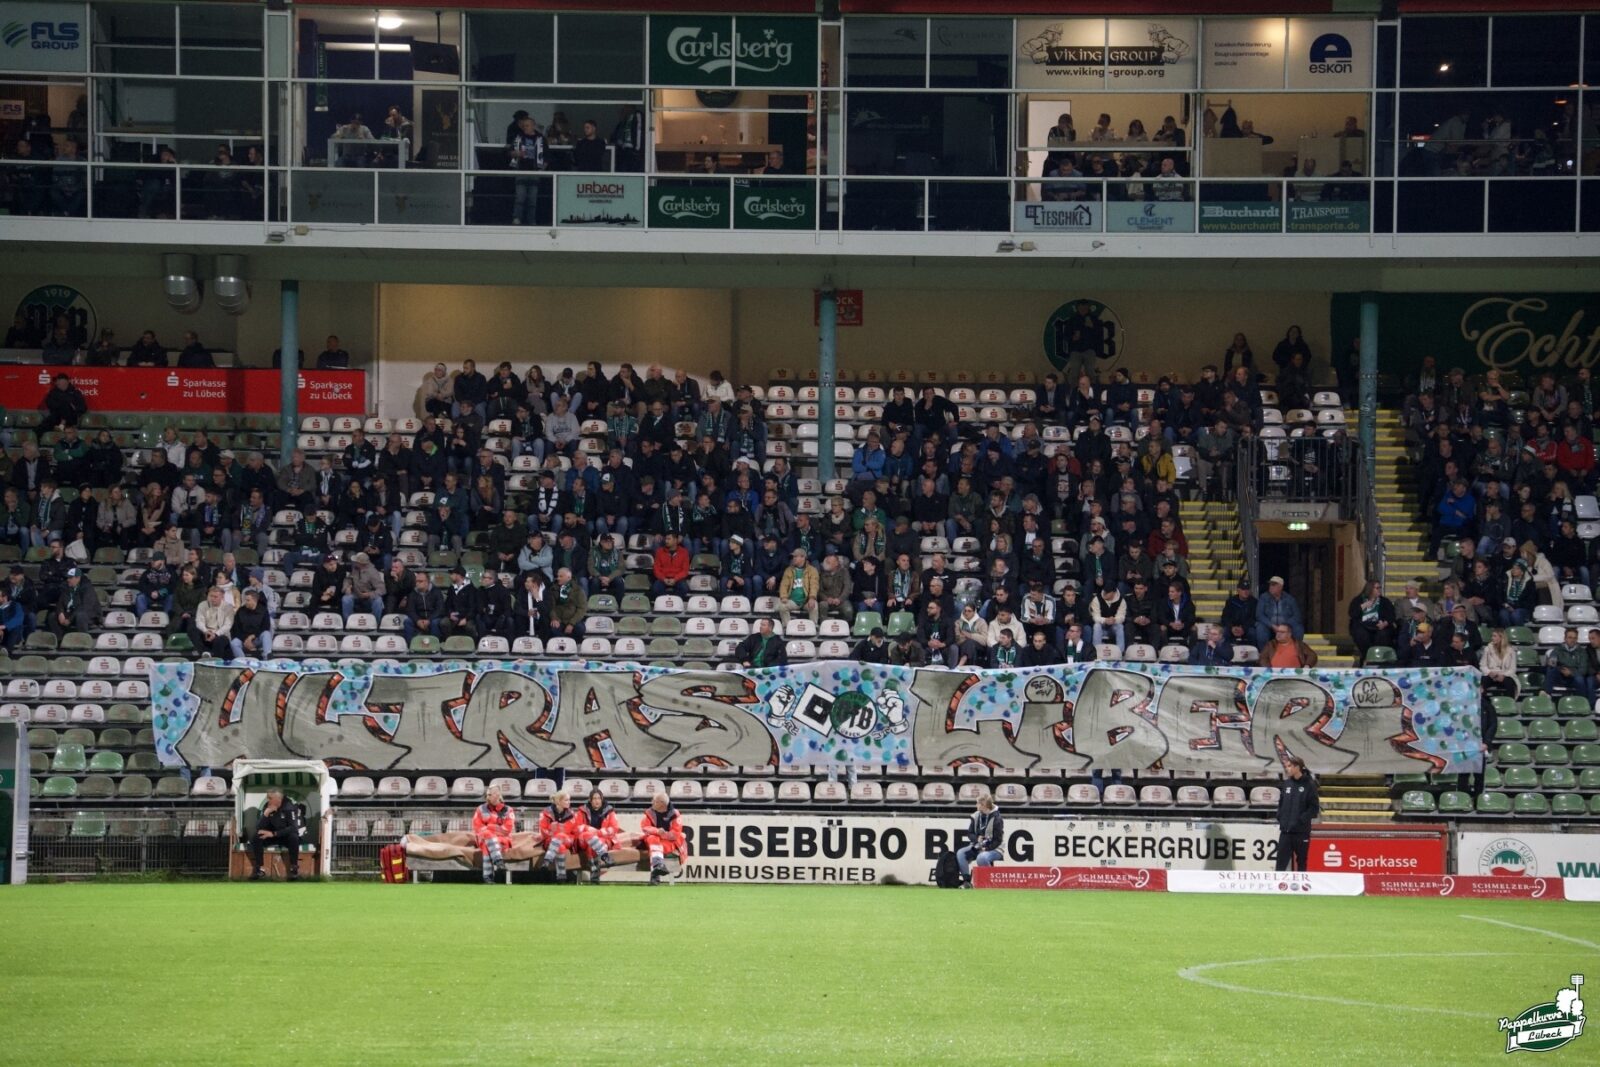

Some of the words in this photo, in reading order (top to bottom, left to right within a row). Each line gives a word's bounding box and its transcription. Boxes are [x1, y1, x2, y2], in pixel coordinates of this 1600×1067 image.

[31, 22, 80, 41] FLS
[31, 41, 80, 50] GROUP
[667, 26, 794, 70] Carlsberg
[1110, 50, 1158, 62] GROUP
[1309, 63, 1353, 74] eskon
[658, 195, 721, 217] Carlsberg
[743, 196, 806, 217] Carlsberg
[1206, 206, 1280, 218] Burchardt
[1127, 216, 1175, 226] CLEMENT
[183, 379, 227, 389] Sparkasse
[310, 381, 353, 391] Sparkasse
[195, 389, 227, 399] Lübeck
[322, 391, 353, 401] Lübeck
[1055, 835, 1246, 860] BECKERGRUBE
[1253, 839, 1280, 861] 32
[1349, 855, 1418, 870] Sparkasse
[990, 871, 1045, 880] SCHMELZER
[1078, 873, 1135, 882] SCHMELZER
[1218, 871, 1311, 882] SCHMELZER
[1380, 881, 1438, 889] SCHMELZER
[1472, 882, 1530, 891] SCHMELZER
